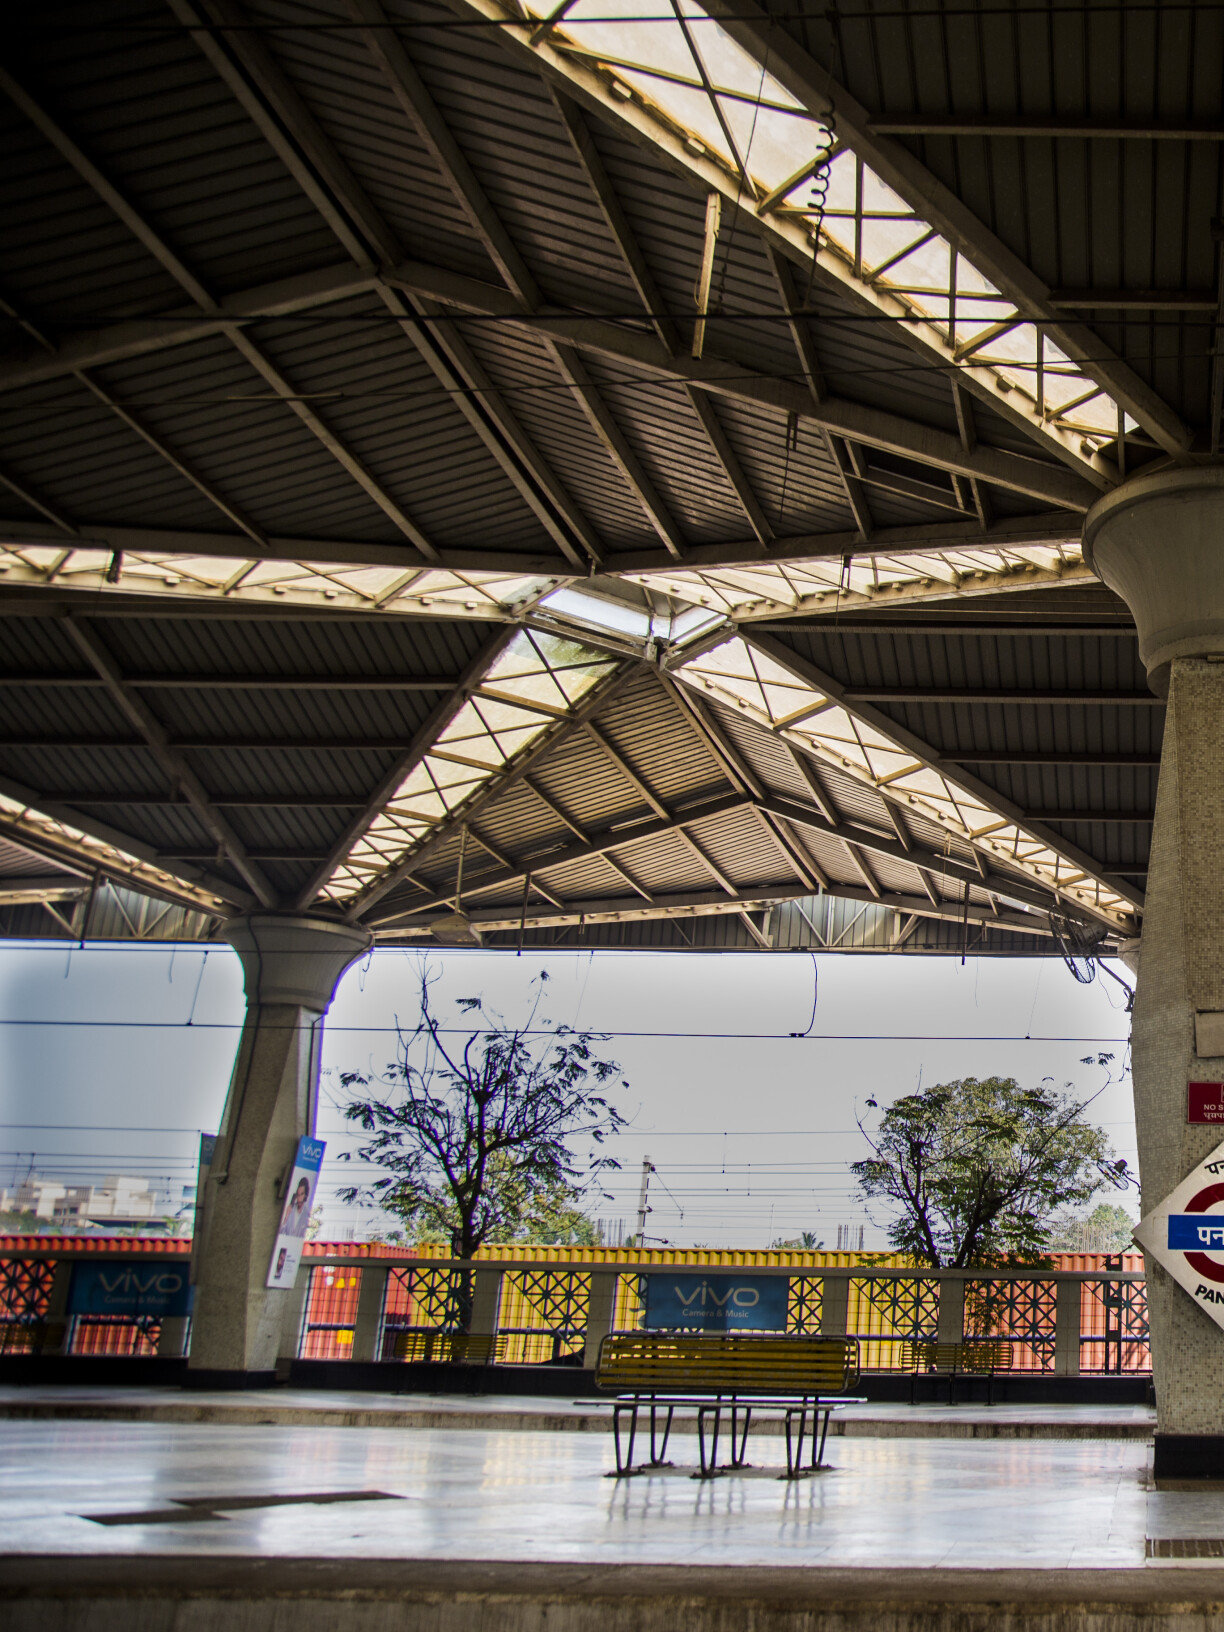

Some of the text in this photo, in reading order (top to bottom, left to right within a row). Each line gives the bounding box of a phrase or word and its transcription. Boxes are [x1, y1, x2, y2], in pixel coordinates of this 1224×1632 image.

[674, 1280, 760, 1307] vivo
[682, 1309, 749, 1318] Camera & Music
